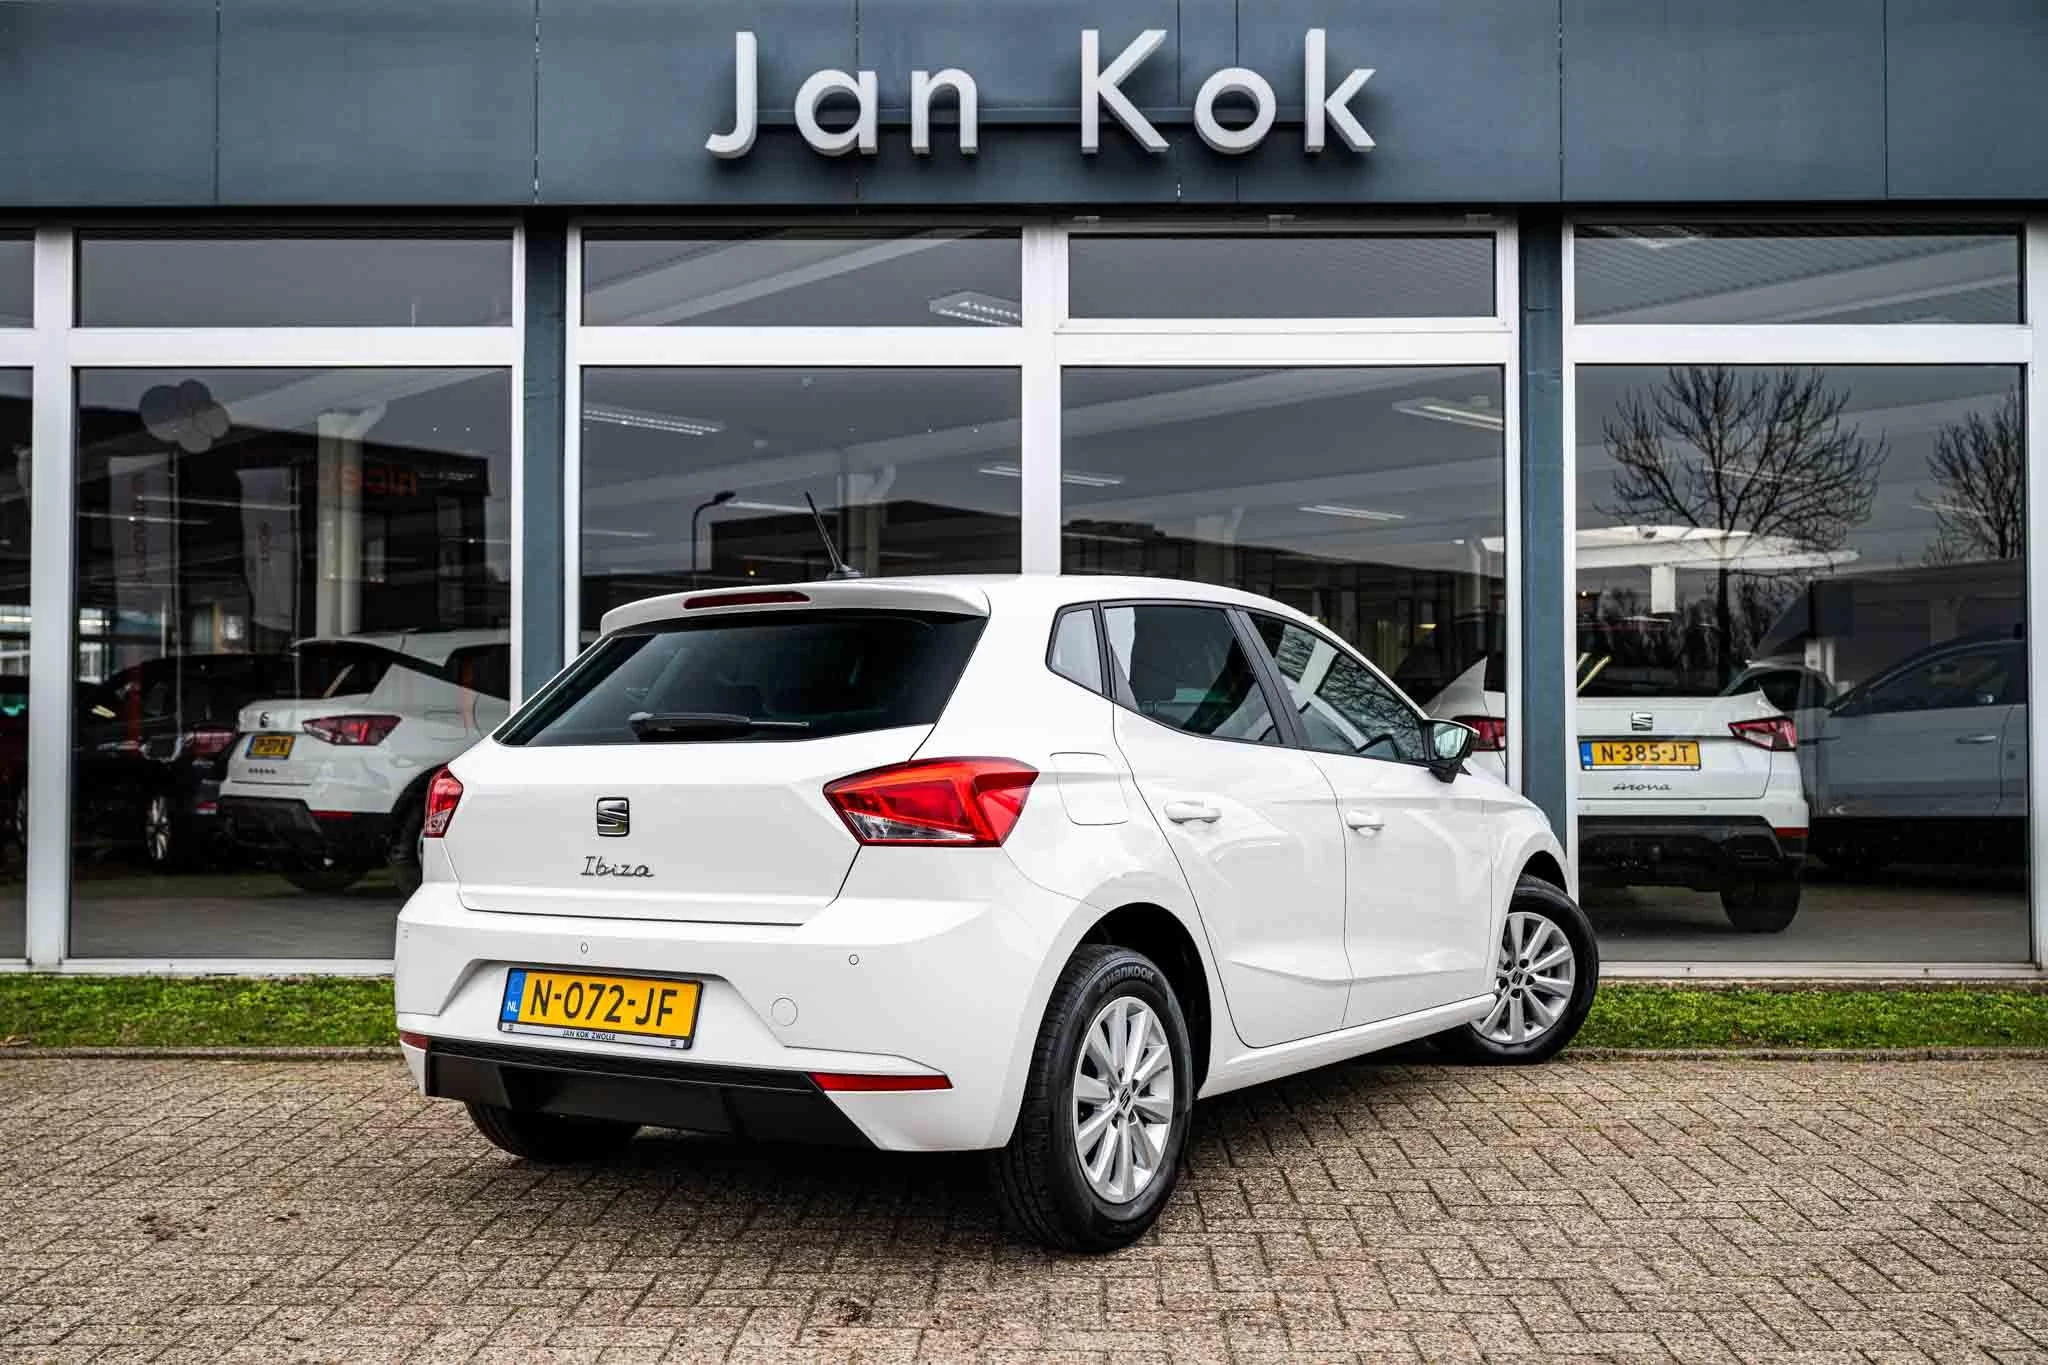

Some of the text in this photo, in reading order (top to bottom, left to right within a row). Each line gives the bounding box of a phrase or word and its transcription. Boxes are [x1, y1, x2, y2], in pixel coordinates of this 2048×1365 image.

[705, 28, 1377, 157] Jan Kok
[1601, 744, 1689, 762] N-385-JT
[580, 855, 654, 878] Ibiza
[506, 1000, 518, 1013] NL
[529, 979, 678, 1027] N-072-JF
[562, 1029, 616, 1041] JAN KOK ZWOLLE
